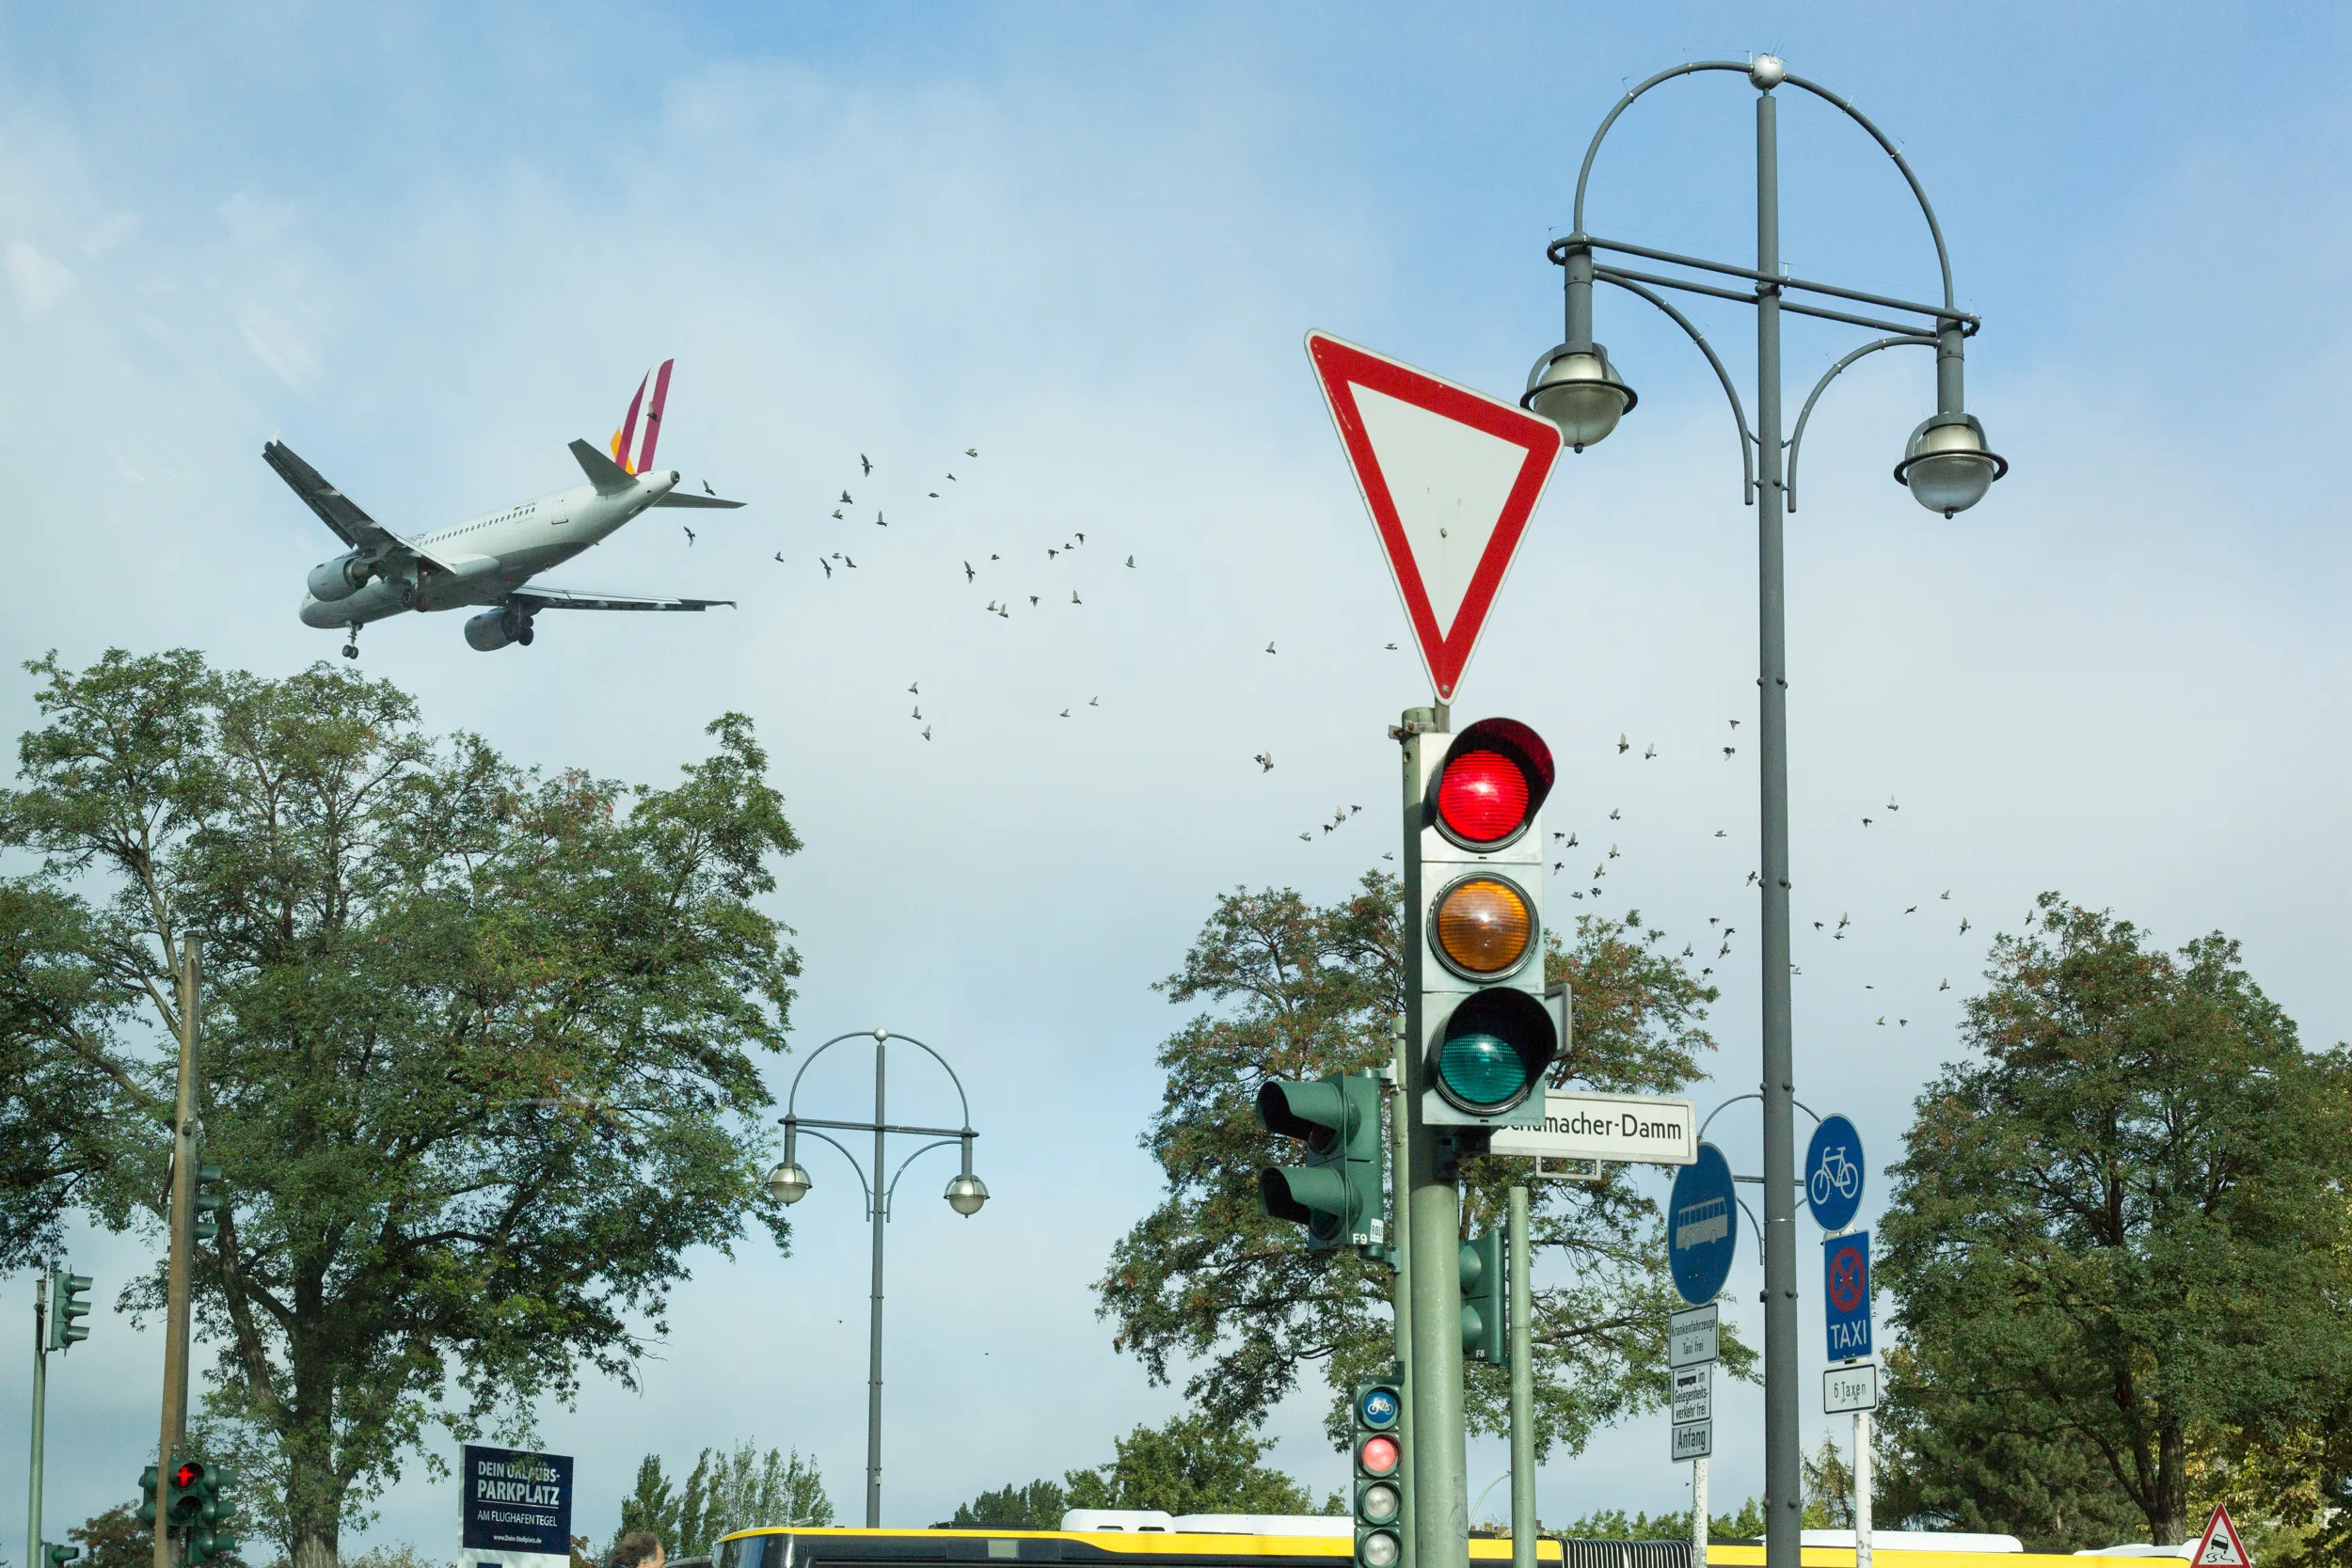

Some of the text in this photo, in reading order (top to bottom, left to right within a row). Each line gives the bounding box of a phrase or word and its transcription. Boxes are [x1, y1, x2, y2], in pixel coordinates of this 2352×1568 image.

[1500, 1111, 1681, 1140] macher-Damm
[1352, 1232, 1368, 1244] F9
[1671, 1319, 1715, 1337] Krankenfahrzeuge
[1830, 1320, 1867, 1350] TAXI
[1475, 1349, 1486, 1357] F8
[1683, 1339, 1704, 1354] Taxi frei
[1698, 1369, 1706, 1383] im
[1675, 1386, 1708, 1404] Gelegenheits-
[1834, 1382, 1867, 1399] 6 Taxen
[1676, 1401, 1706, 1419] verkehr frei
[1677, 1428, 1706, 1450] Anfang
[478, 1461, 504, 1478] DEIN
[477, 1480, 560, 1506] PARKPLATZ
[477, 1510, 558, 1527] AM FLUGHAFEN TEGEL
